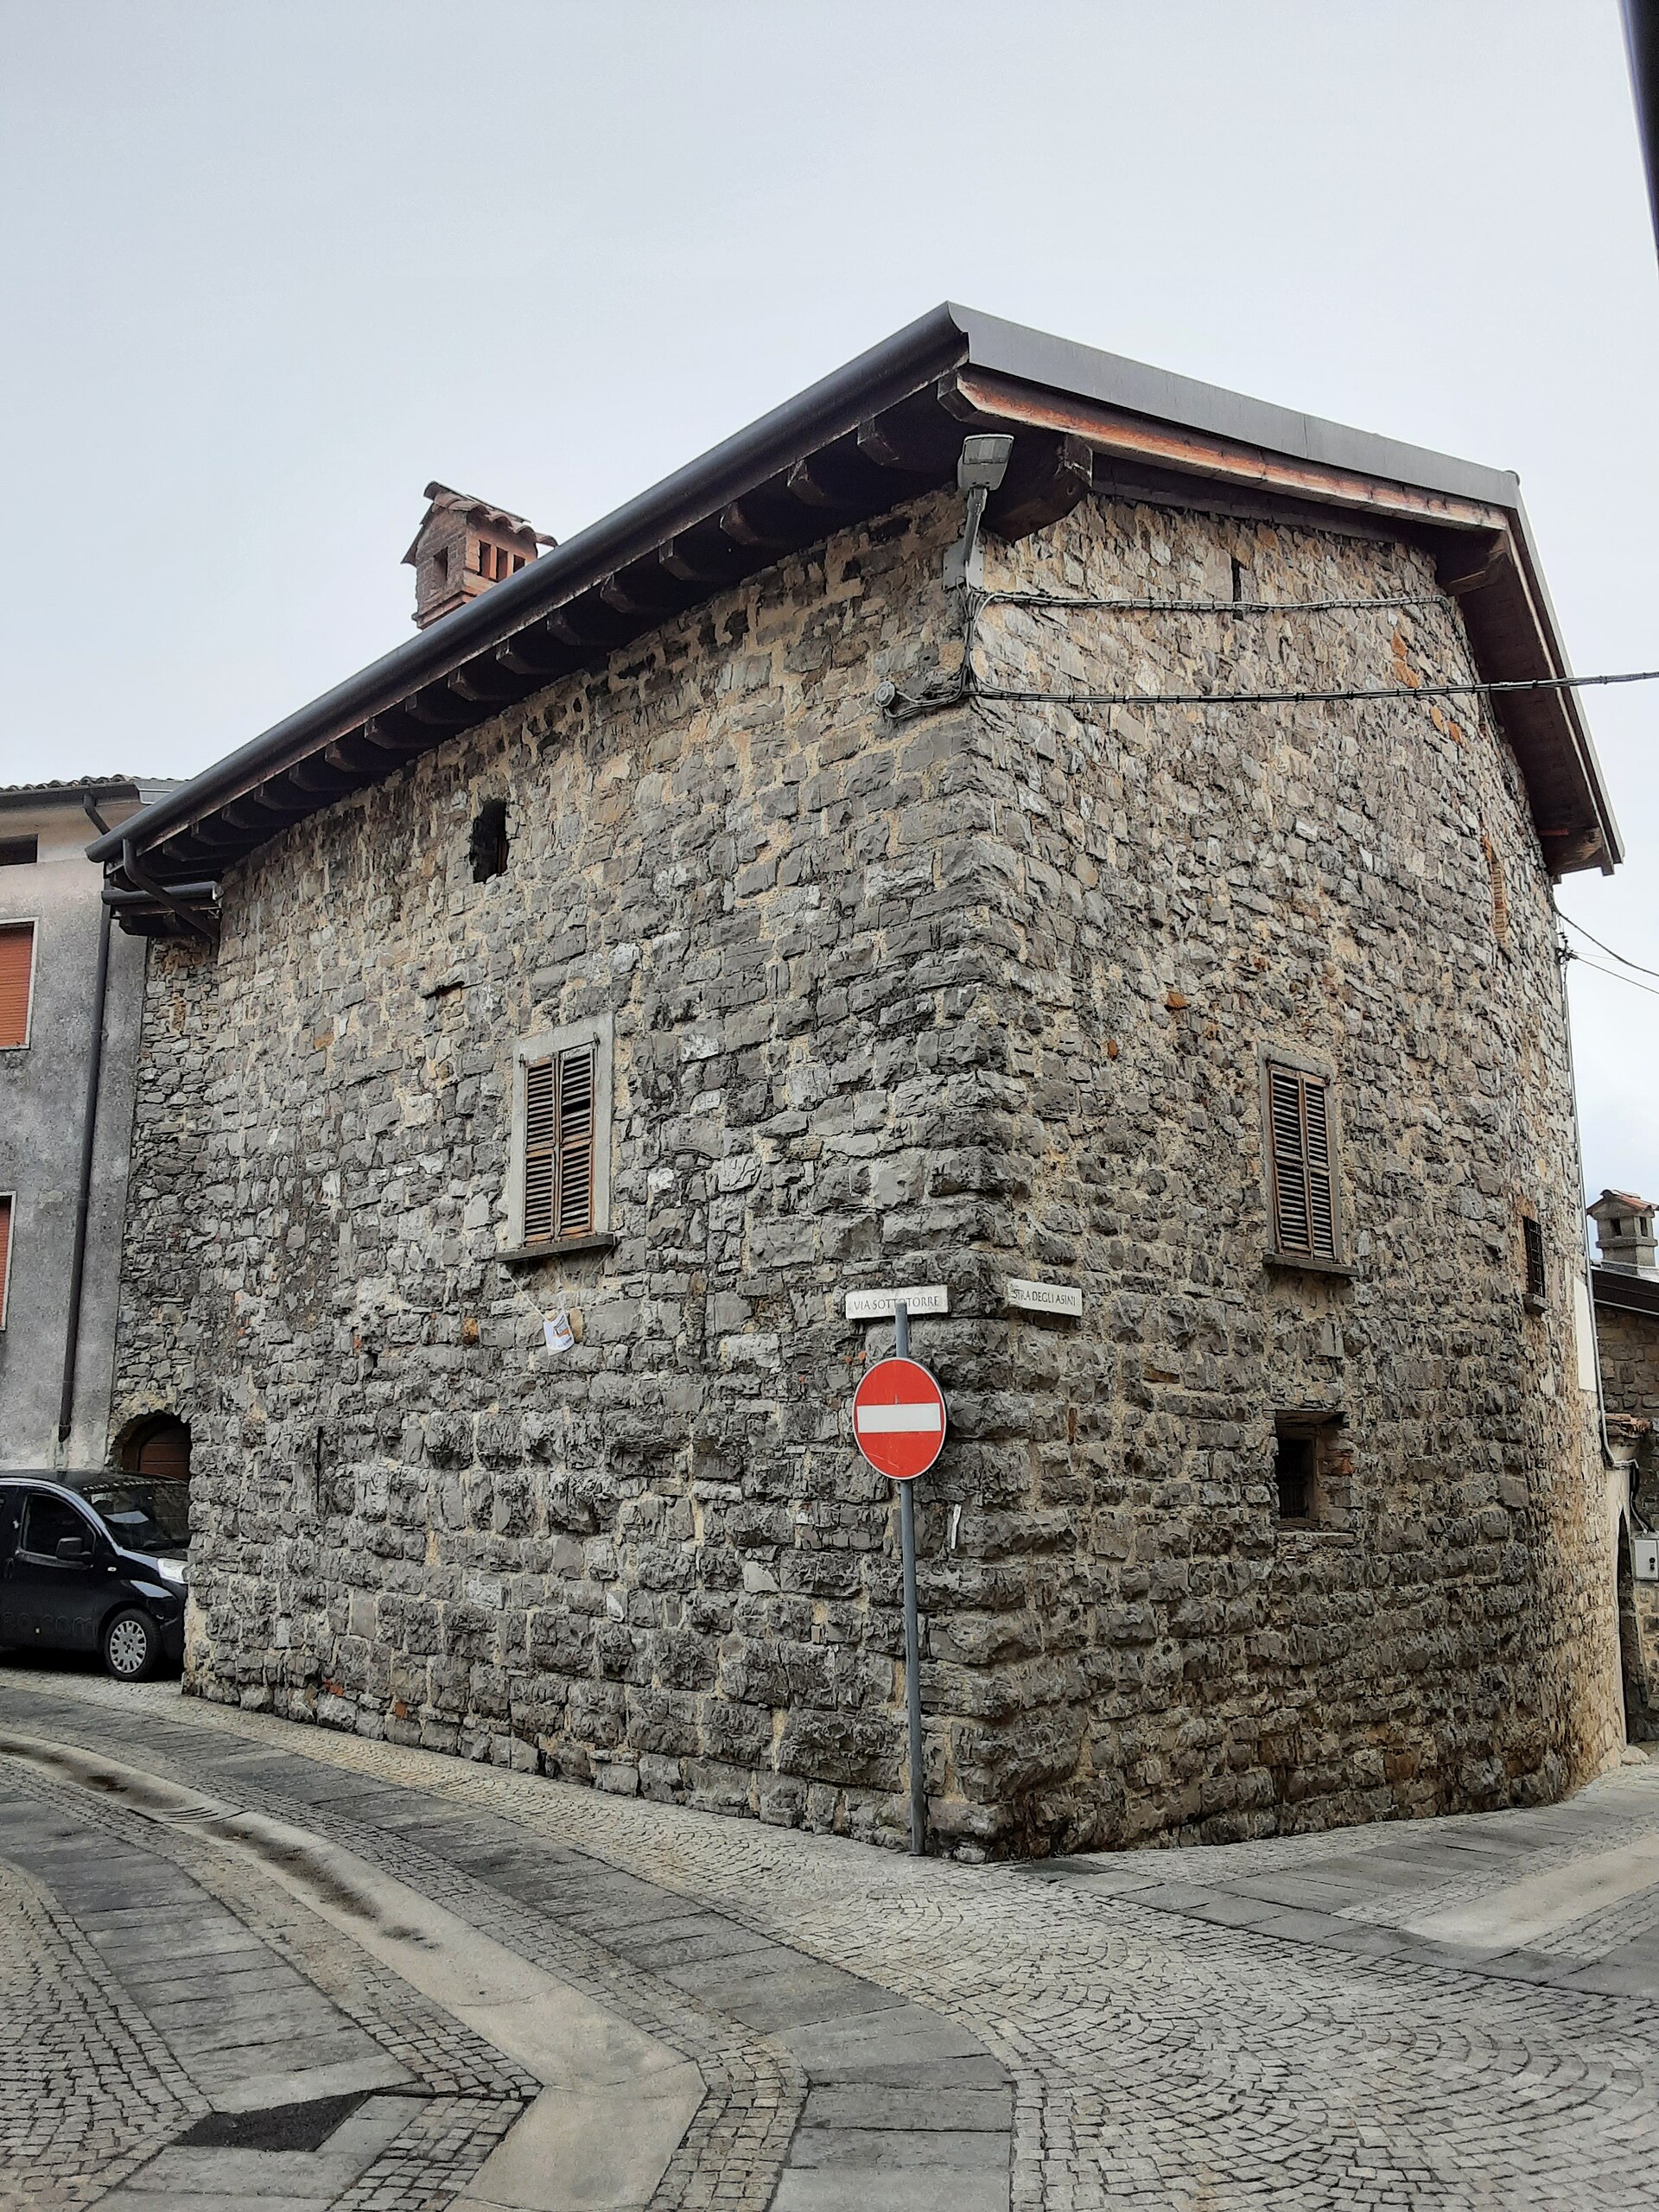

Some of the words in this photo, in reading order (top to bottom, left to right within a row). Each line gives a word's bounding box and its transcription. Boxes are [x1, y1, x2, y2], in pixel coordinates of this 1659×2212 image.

[854, 1299, 871, 1311] VIA
[1032, 1291, 1053, 1303] DEGLI
[1055, 1294, 1076, 1306] ASINI
